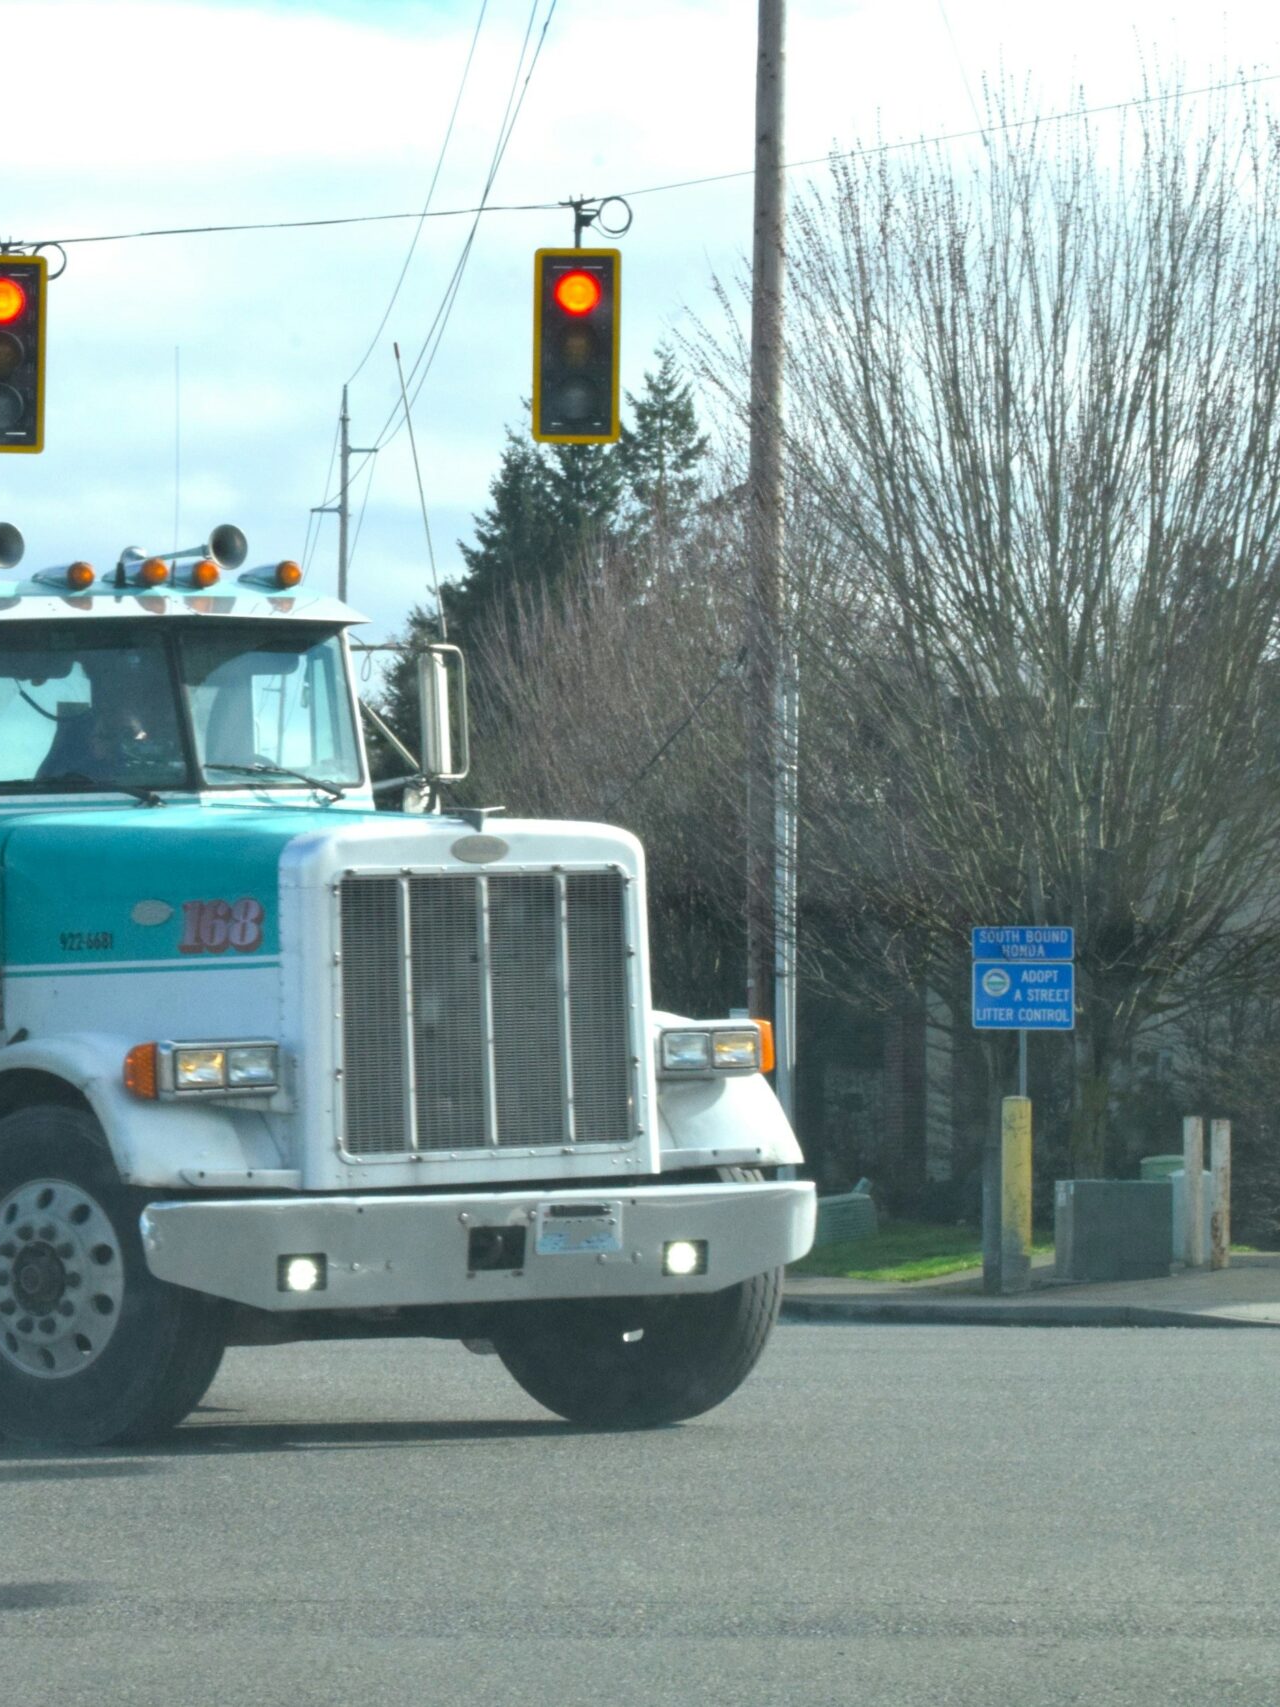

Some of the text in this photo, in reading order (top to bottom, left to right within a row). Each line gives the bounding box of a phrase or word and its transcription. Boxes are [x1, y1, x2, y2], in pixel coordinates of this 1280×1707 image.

[178, 896, 265, 954] 168
[980, 930, 1068, 943] SOUTH BOUND
[1002, 944, 1045, 957] HONDA
[1020, 970, 1058, 983] ADOPT
[1014, 989, 1069, 1002] A STREET
[976, 1008, 1070, 1022] LITTER CONTROL
